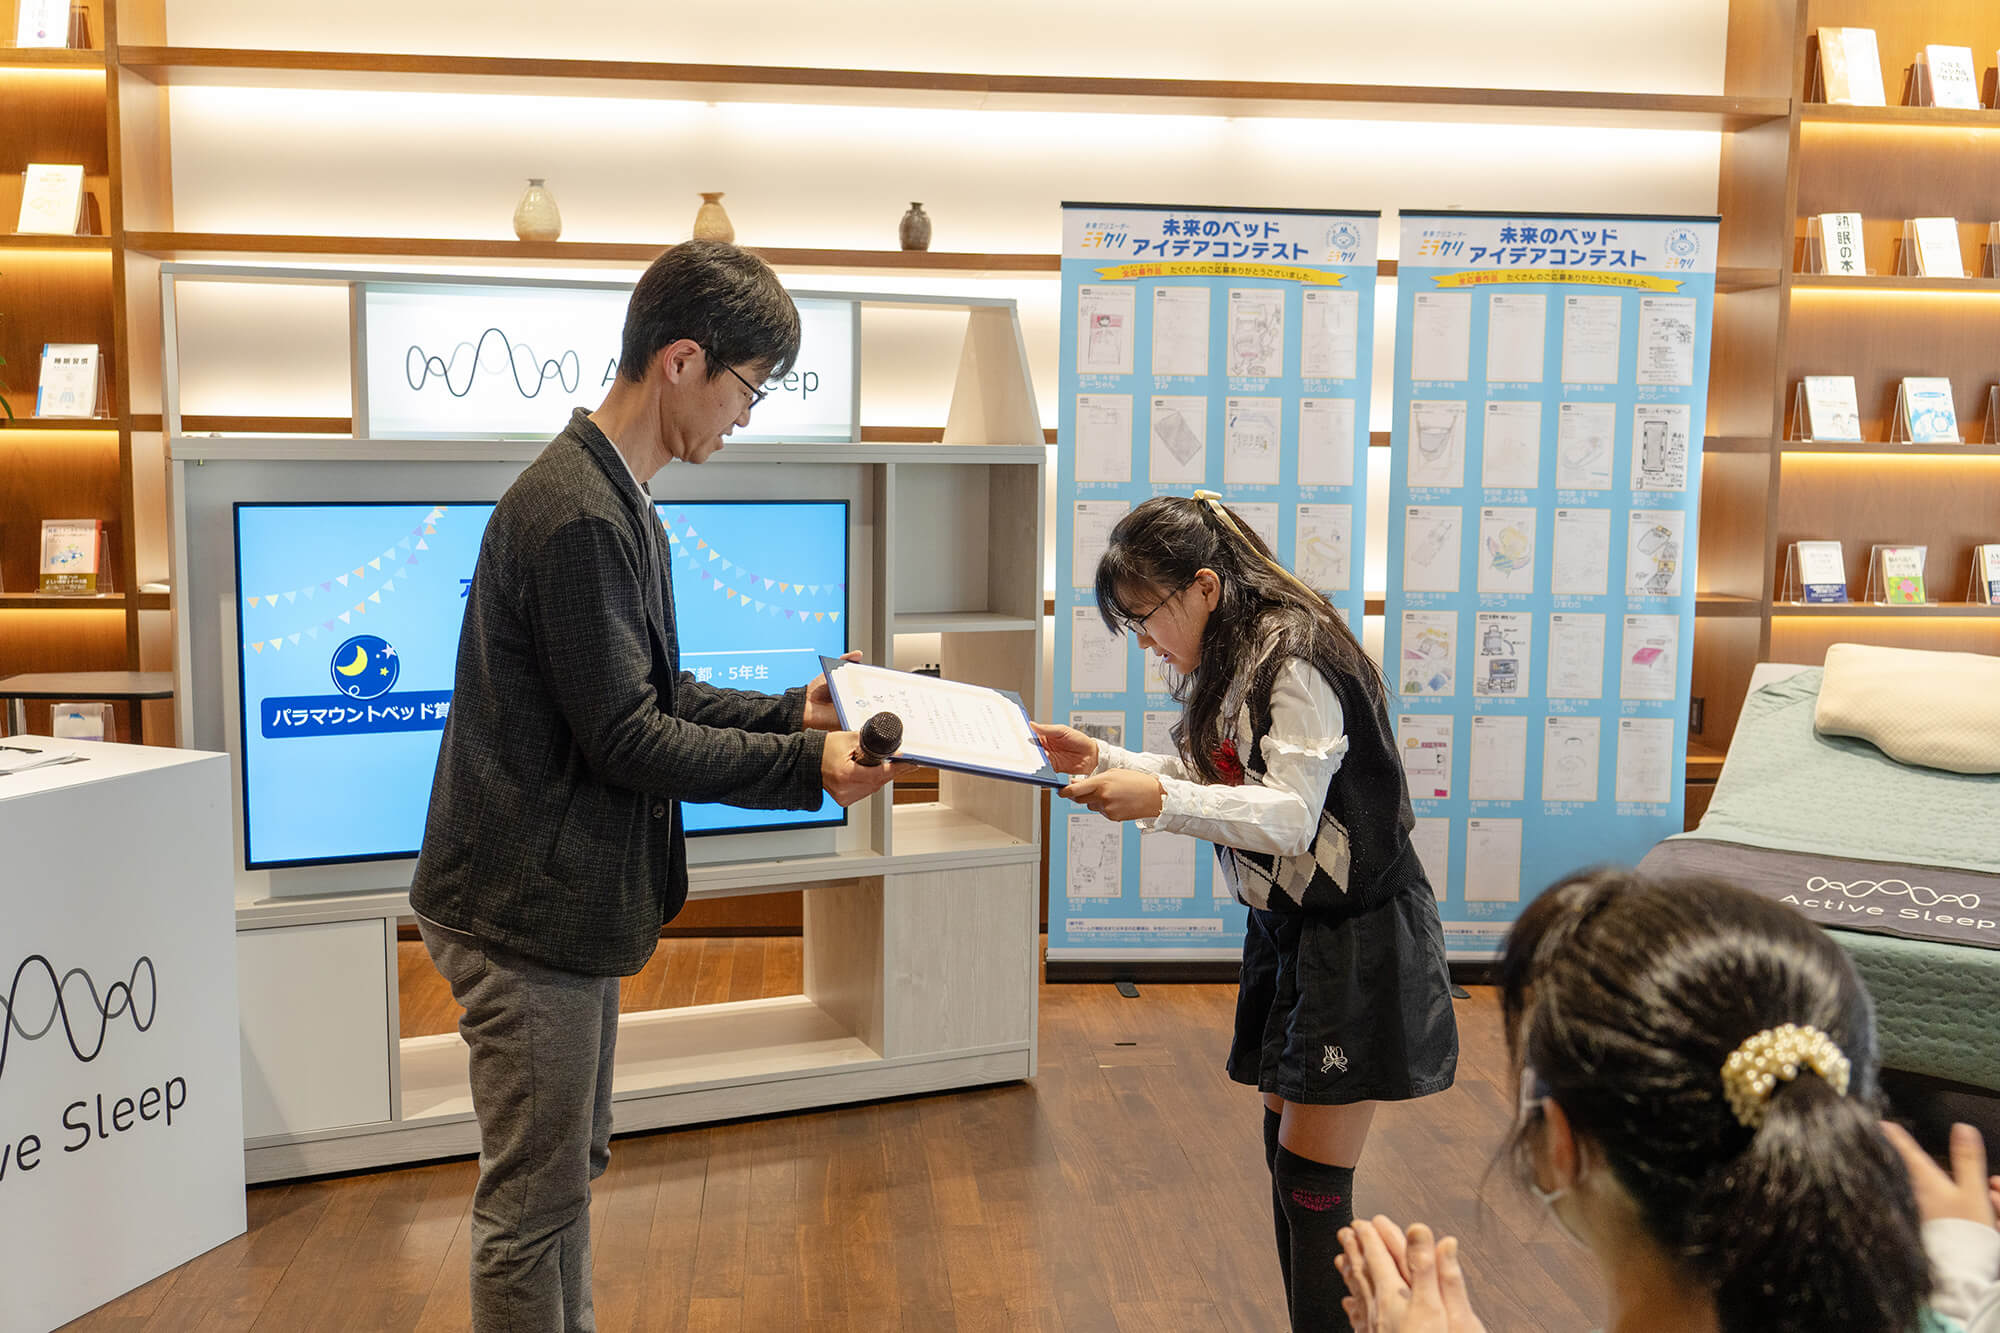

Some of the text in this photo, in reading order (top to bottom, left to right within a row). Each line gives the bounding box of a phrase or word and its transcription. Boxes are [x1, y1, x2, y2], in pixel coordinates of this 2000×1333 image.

[1162, 218, 1280, 239] 未来のベッド
[1500, 225, 1618, 246] 未来のベッド
[1132, 238, 1309, 261] アイデアコンテスト
[1469, 246, 1648, 269] アイデアコンテスト
[272, 701, 451, 727] パラマウントベッド賞
[1778, 893, 1997, 930] Active Sleep
[62, 1076, 187, 1153] Sleep
